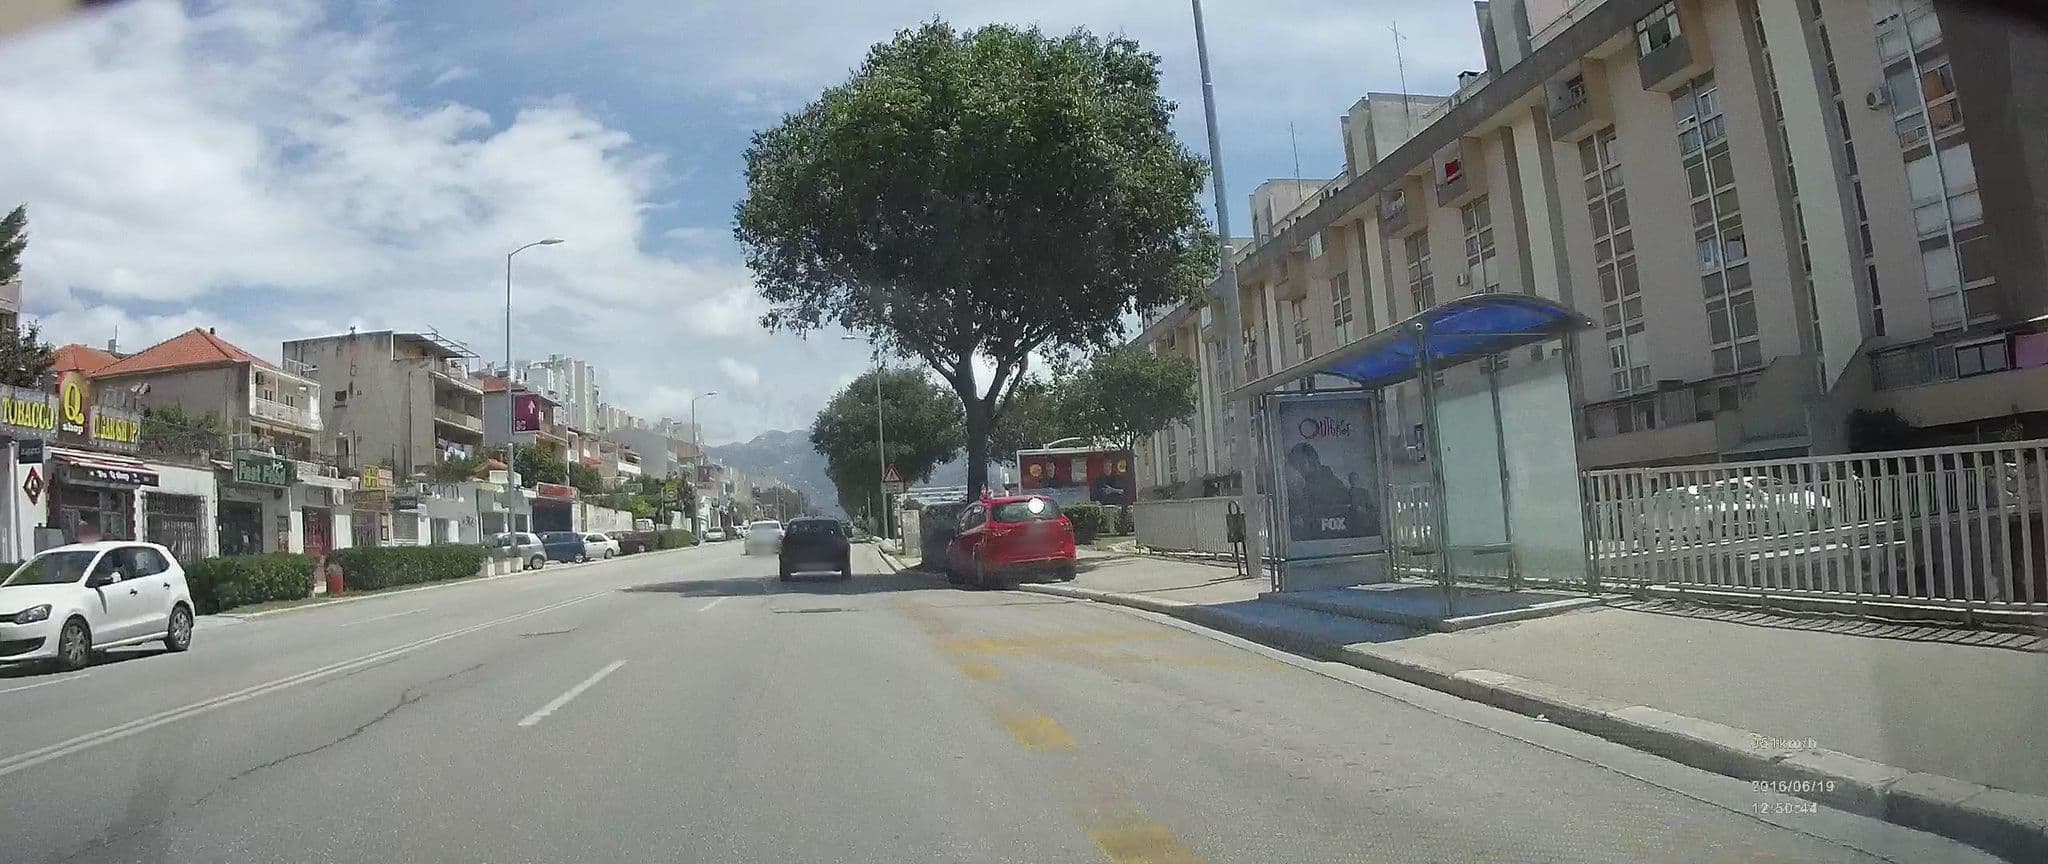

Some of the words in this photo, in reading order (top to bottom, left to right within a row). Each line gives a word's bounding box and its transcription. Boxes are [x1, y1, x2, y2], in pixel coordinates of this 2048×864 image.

[1, 397, 55, 430] TOBACCO
[64, 383, 84, 424] Q
[62, 422, 83, 435] shop
[239, 460, 260, 482] Fast
[263, 462, 286, 485] Food
[1321, 517, 1346, 531] FOX
